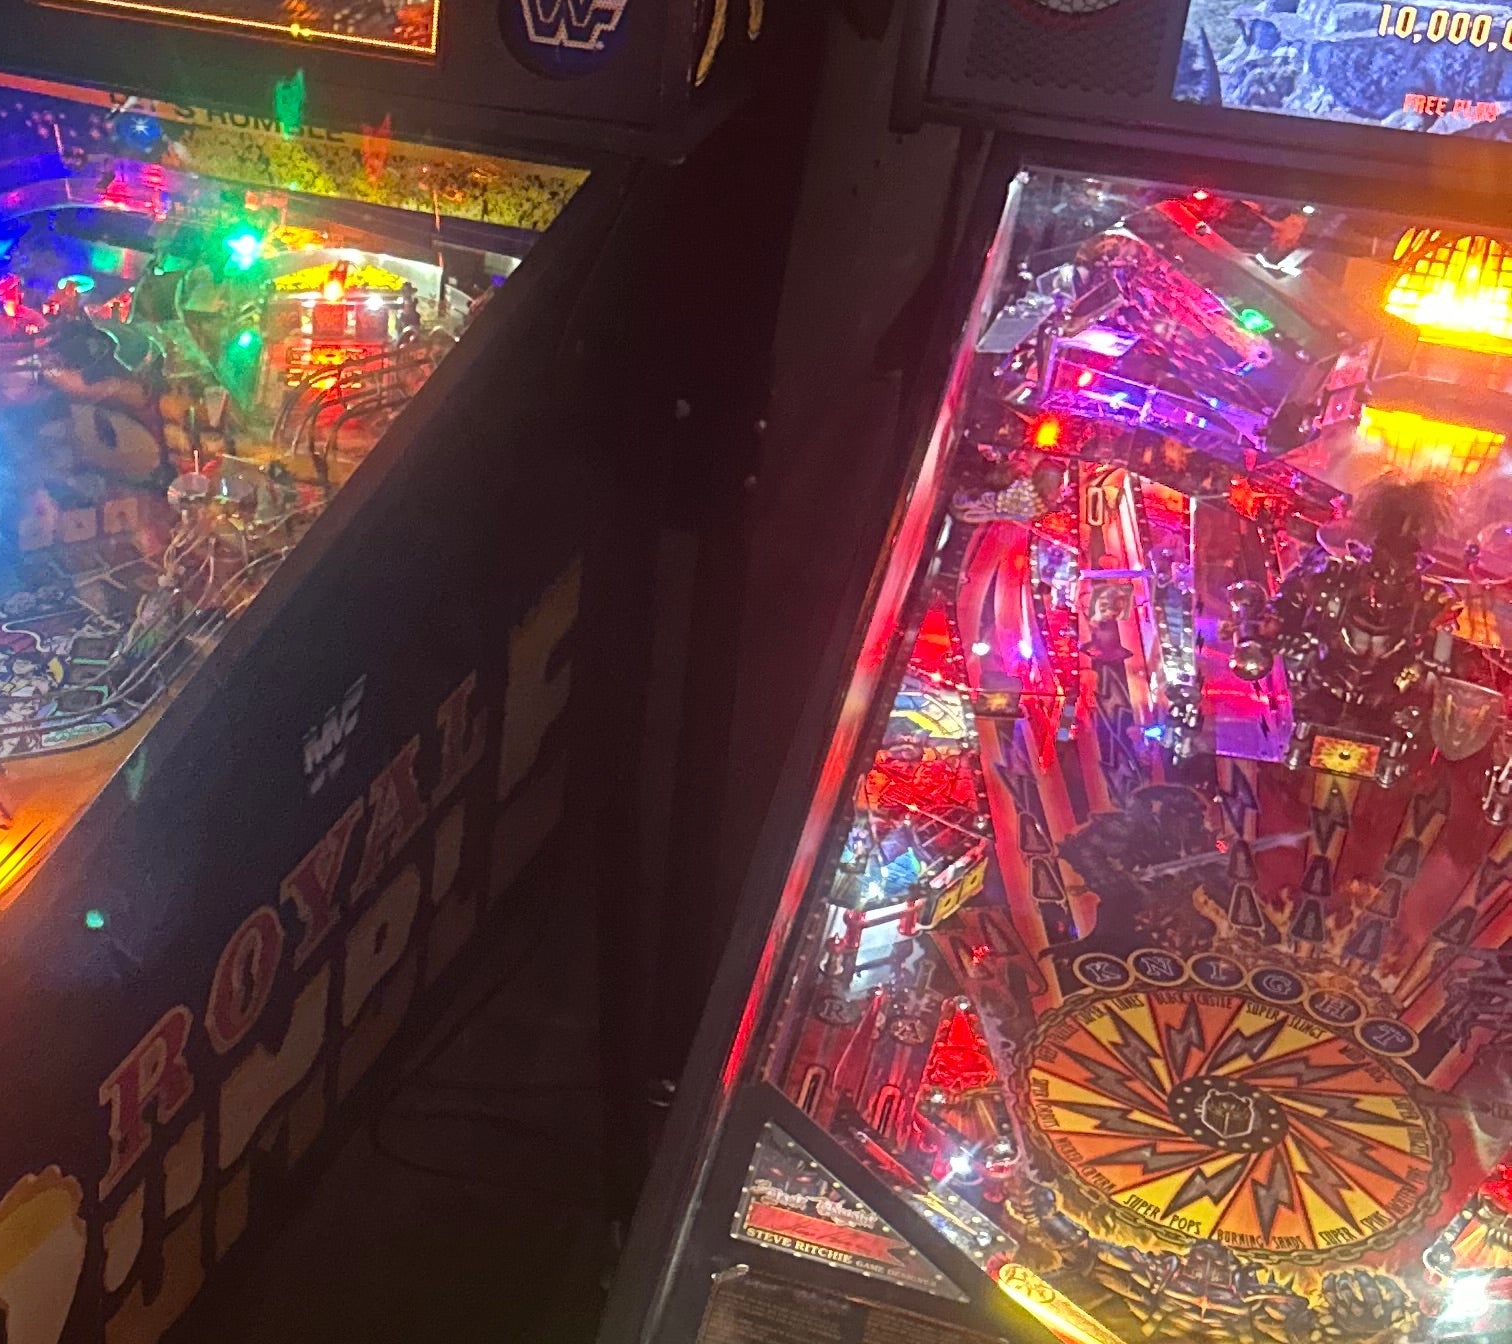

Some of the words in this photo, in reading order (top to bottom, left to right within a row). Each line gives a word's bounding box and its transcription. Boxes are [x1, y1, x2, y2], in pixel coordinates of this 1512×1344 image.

[1403, 93, 1446, 117] FREE
[1452, 99, 1501, 123] PLAY
[99, 670, 489, 1199] ROYAL
[1245, 1002, 1281, 1021] SUPER
[1288, 1013, 1328, 1040] SLINGS
[1123, 1193, 1162, 1219] SUPER
[1169, 1215, 1204, 1237] POPS
[1318, 1225, 1355, 1249] SUPER
[1360, 1210, 1390, 1233] SPINS
[746, 1227, 793, 1248] STEVE
[794, 1239, 854, 1266] RITCHIE
[855, 1260, 885, 1274] GAME
[1217, 1229, 1266, 1249] BURNING
[1272, 1235, 1307, 1250] SANDS
